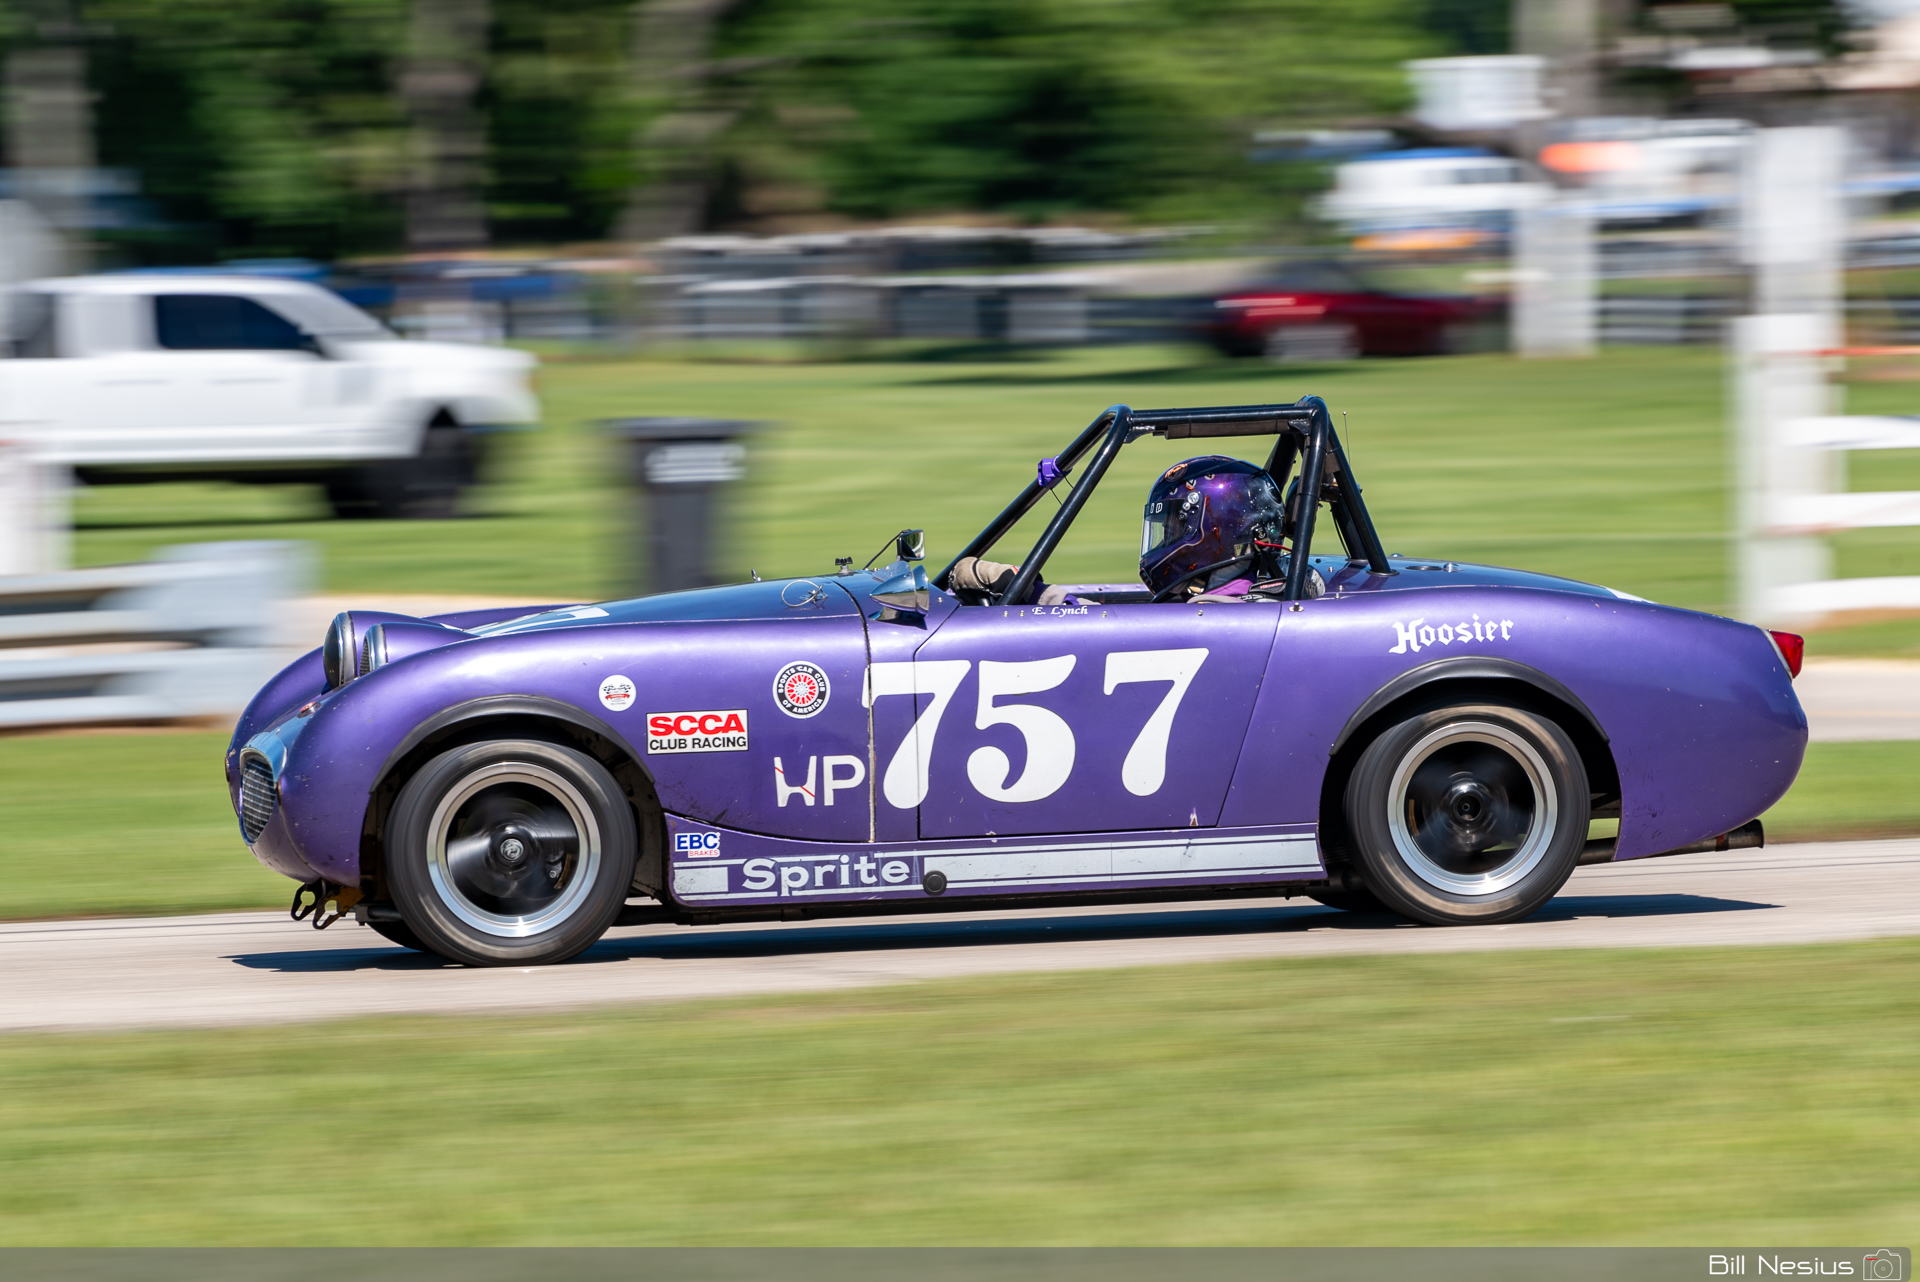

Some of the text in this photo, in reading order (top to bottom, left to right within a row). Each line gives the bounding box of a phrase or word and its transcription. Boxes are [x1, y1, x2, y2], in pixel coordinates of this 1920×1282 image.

[1031, 605, 1089, 618] E. Lynch
[1388, 612, 1514, 655] Hoosier
[778, 668, 796, 693] SPORTS
[815, 674, 825, 691] CLUB
[782, 698, 823, 714] OF AMERICA
[649, 713, 745, 737] SCCA
[861, 647, 1210, 809] 757
[649, 736, 747, 751] CLUB RACING
[676, 832, 718, 849] EBC
[742, 855, 909, 896] Sprite
